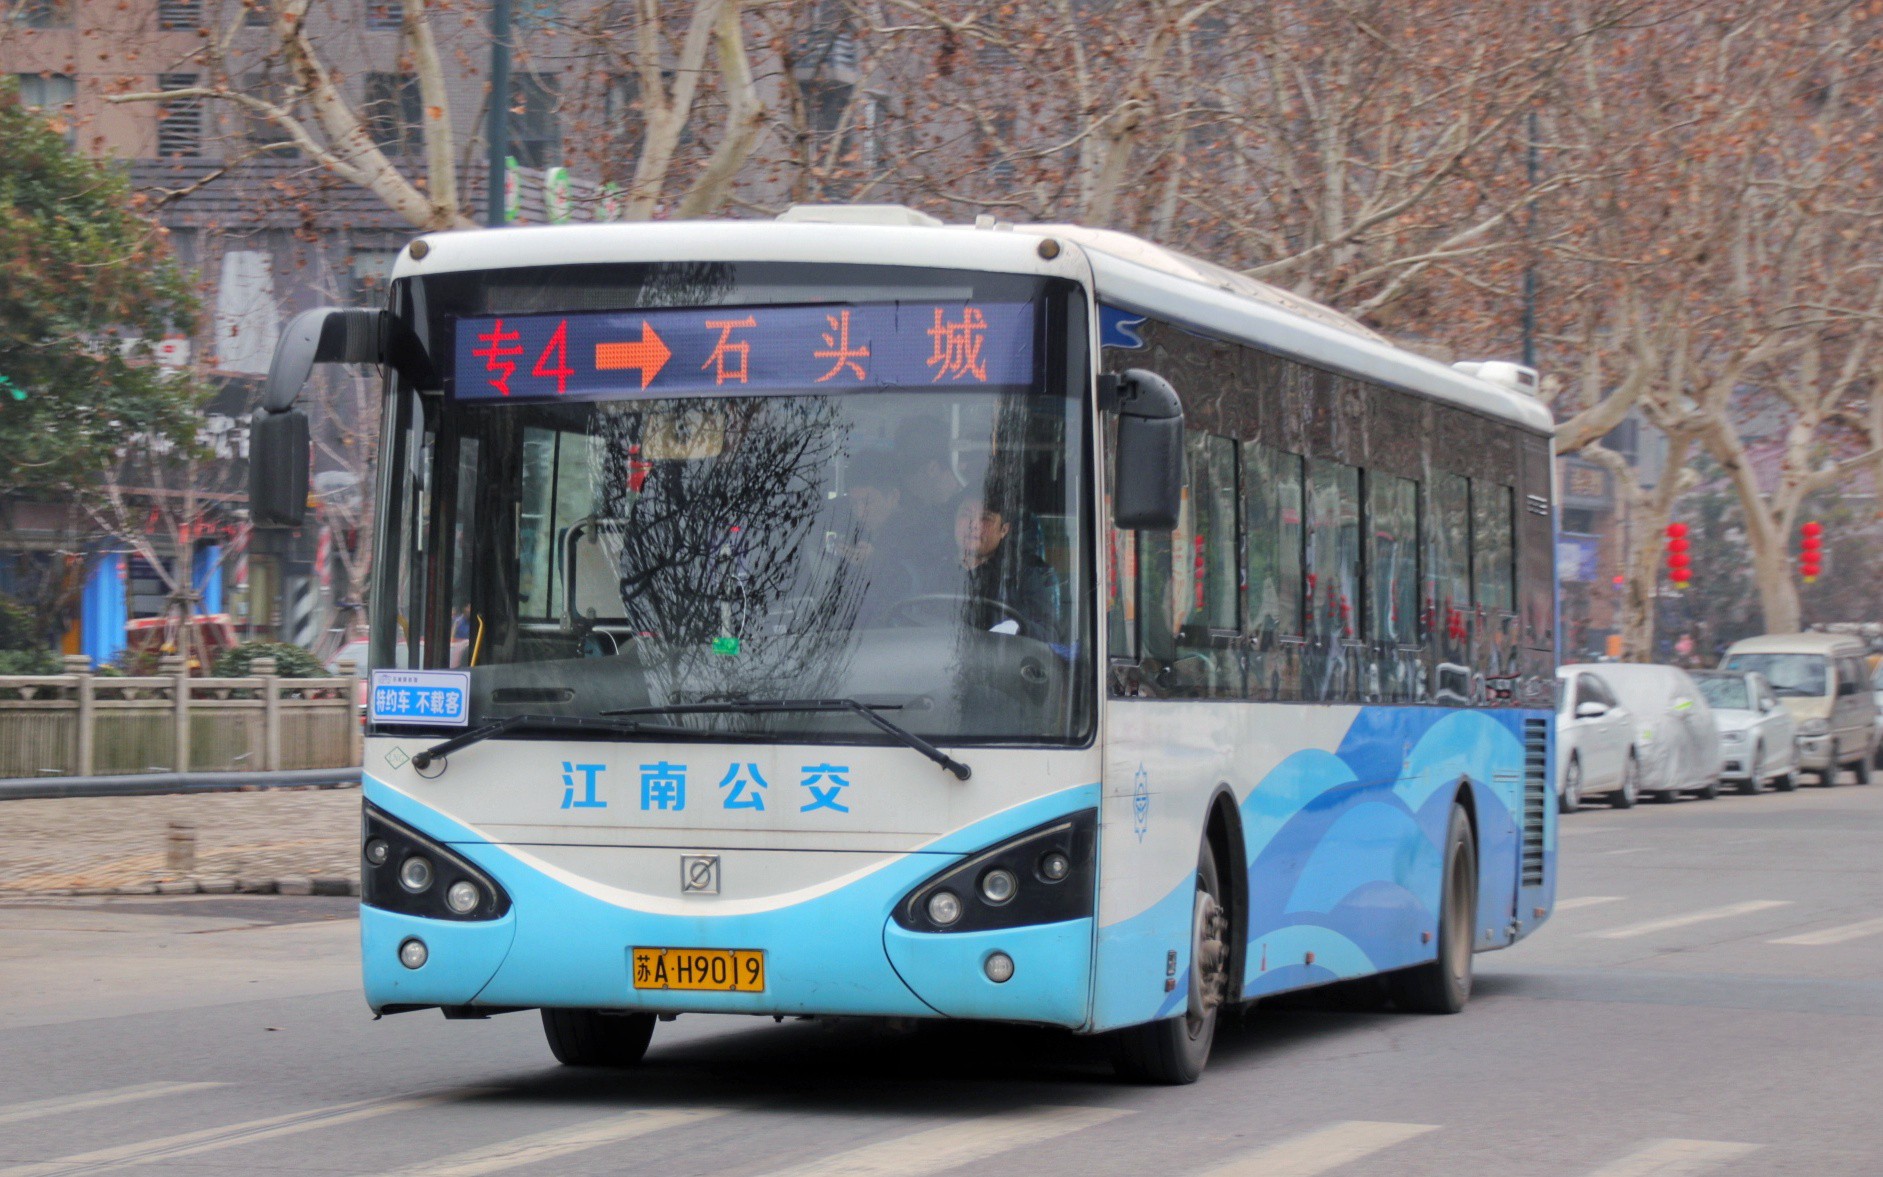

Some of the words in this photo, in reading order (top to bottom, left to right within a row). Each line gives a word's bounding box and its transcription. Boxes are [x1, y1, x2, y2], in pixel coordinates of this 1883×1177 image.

[472, 319, 575, 396] 专4
[701, 307, 988, 386] 石头城
[376, 689, 410, 713] 特约车
[416, 690, 459, 714] 不载客
[560, 761, 850, 813] 江南公交
[637, 955, 760, 984] 苏A·H9019
